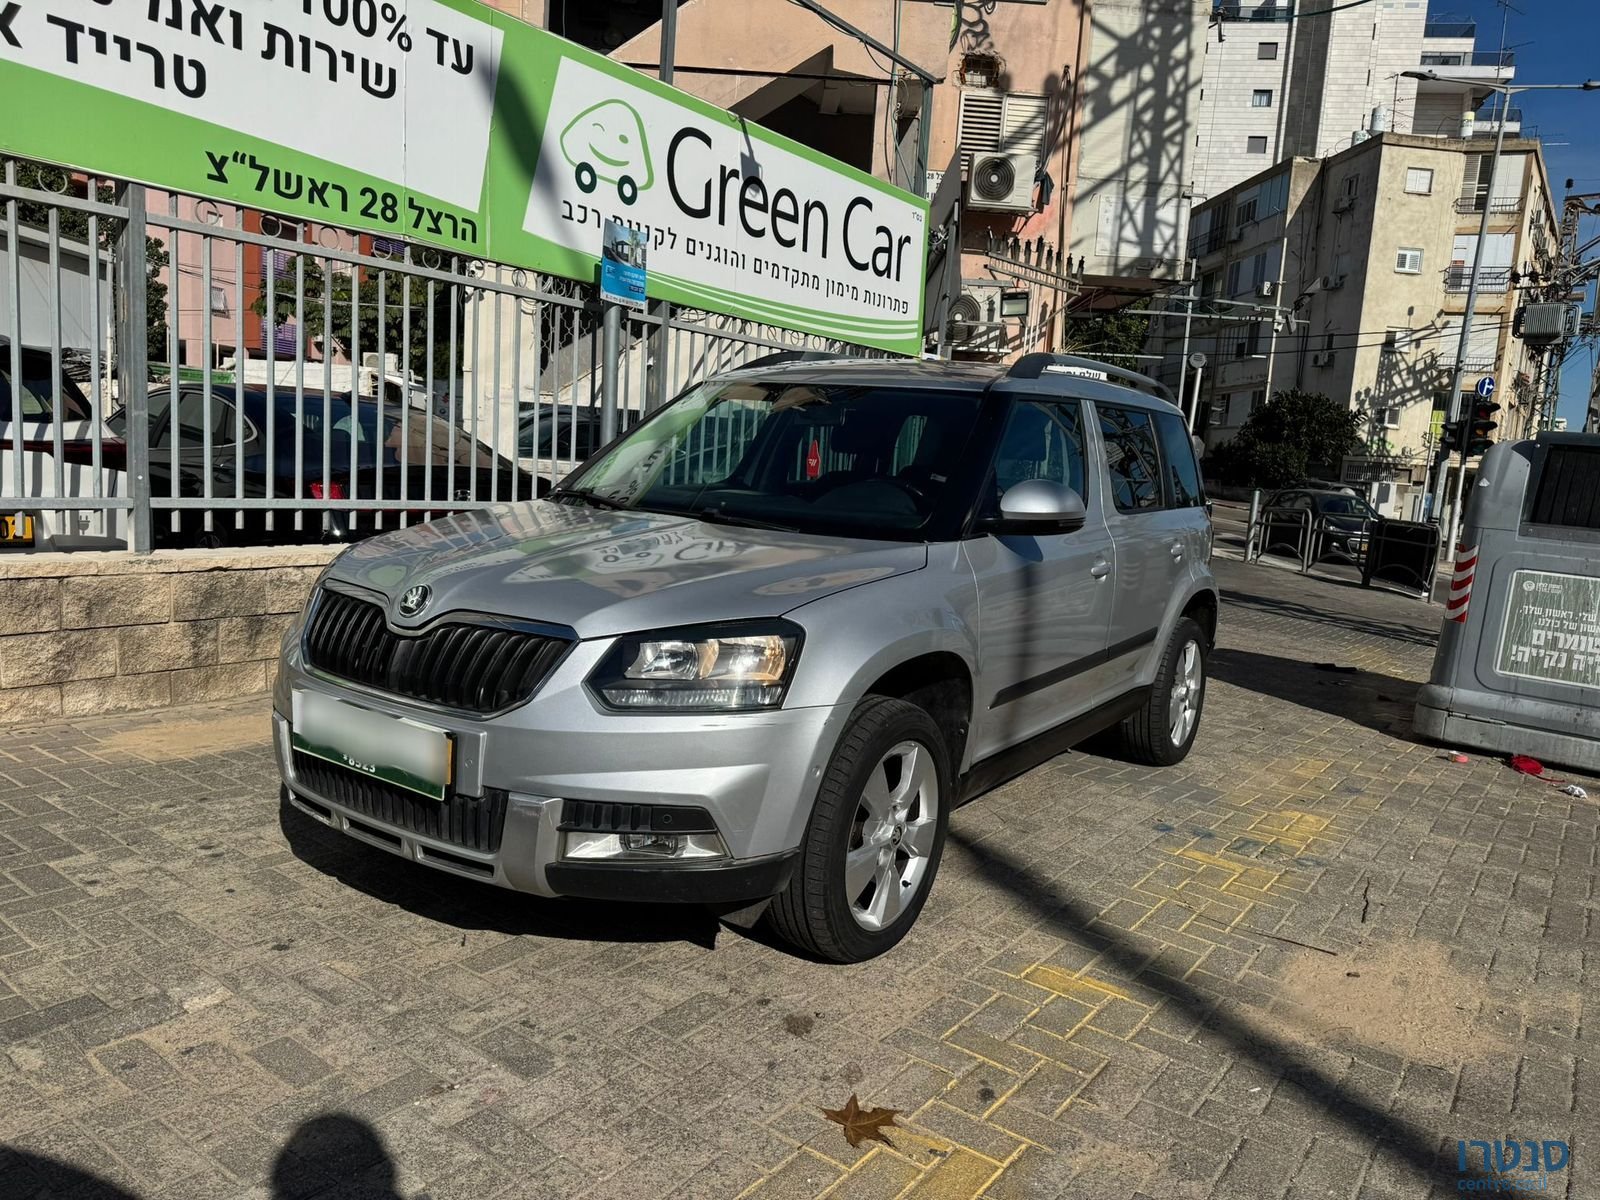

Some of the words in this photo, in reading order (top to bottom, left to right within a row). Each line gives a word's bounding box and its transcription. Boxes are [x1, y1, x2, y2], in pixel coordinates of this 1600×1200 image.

[46, 13, 207, 99] טרייד
[261, 23, 396, 99] שירות
[426, 27, 473, 75] עד
[360, 186, 399, 224] 28
[408, 196, 477, 244] הרצל
[561, 199, 602, 229] רכב
[667, 127, 829, 259] Green
[843, 196, 912, 282] Car
[686, 237, 746, 270] והוגנים
[753, 257, 820, 289] מתקדמים
[826, 278, 859, 301] מימון
[863, 289, 909, 315] פתרונות
